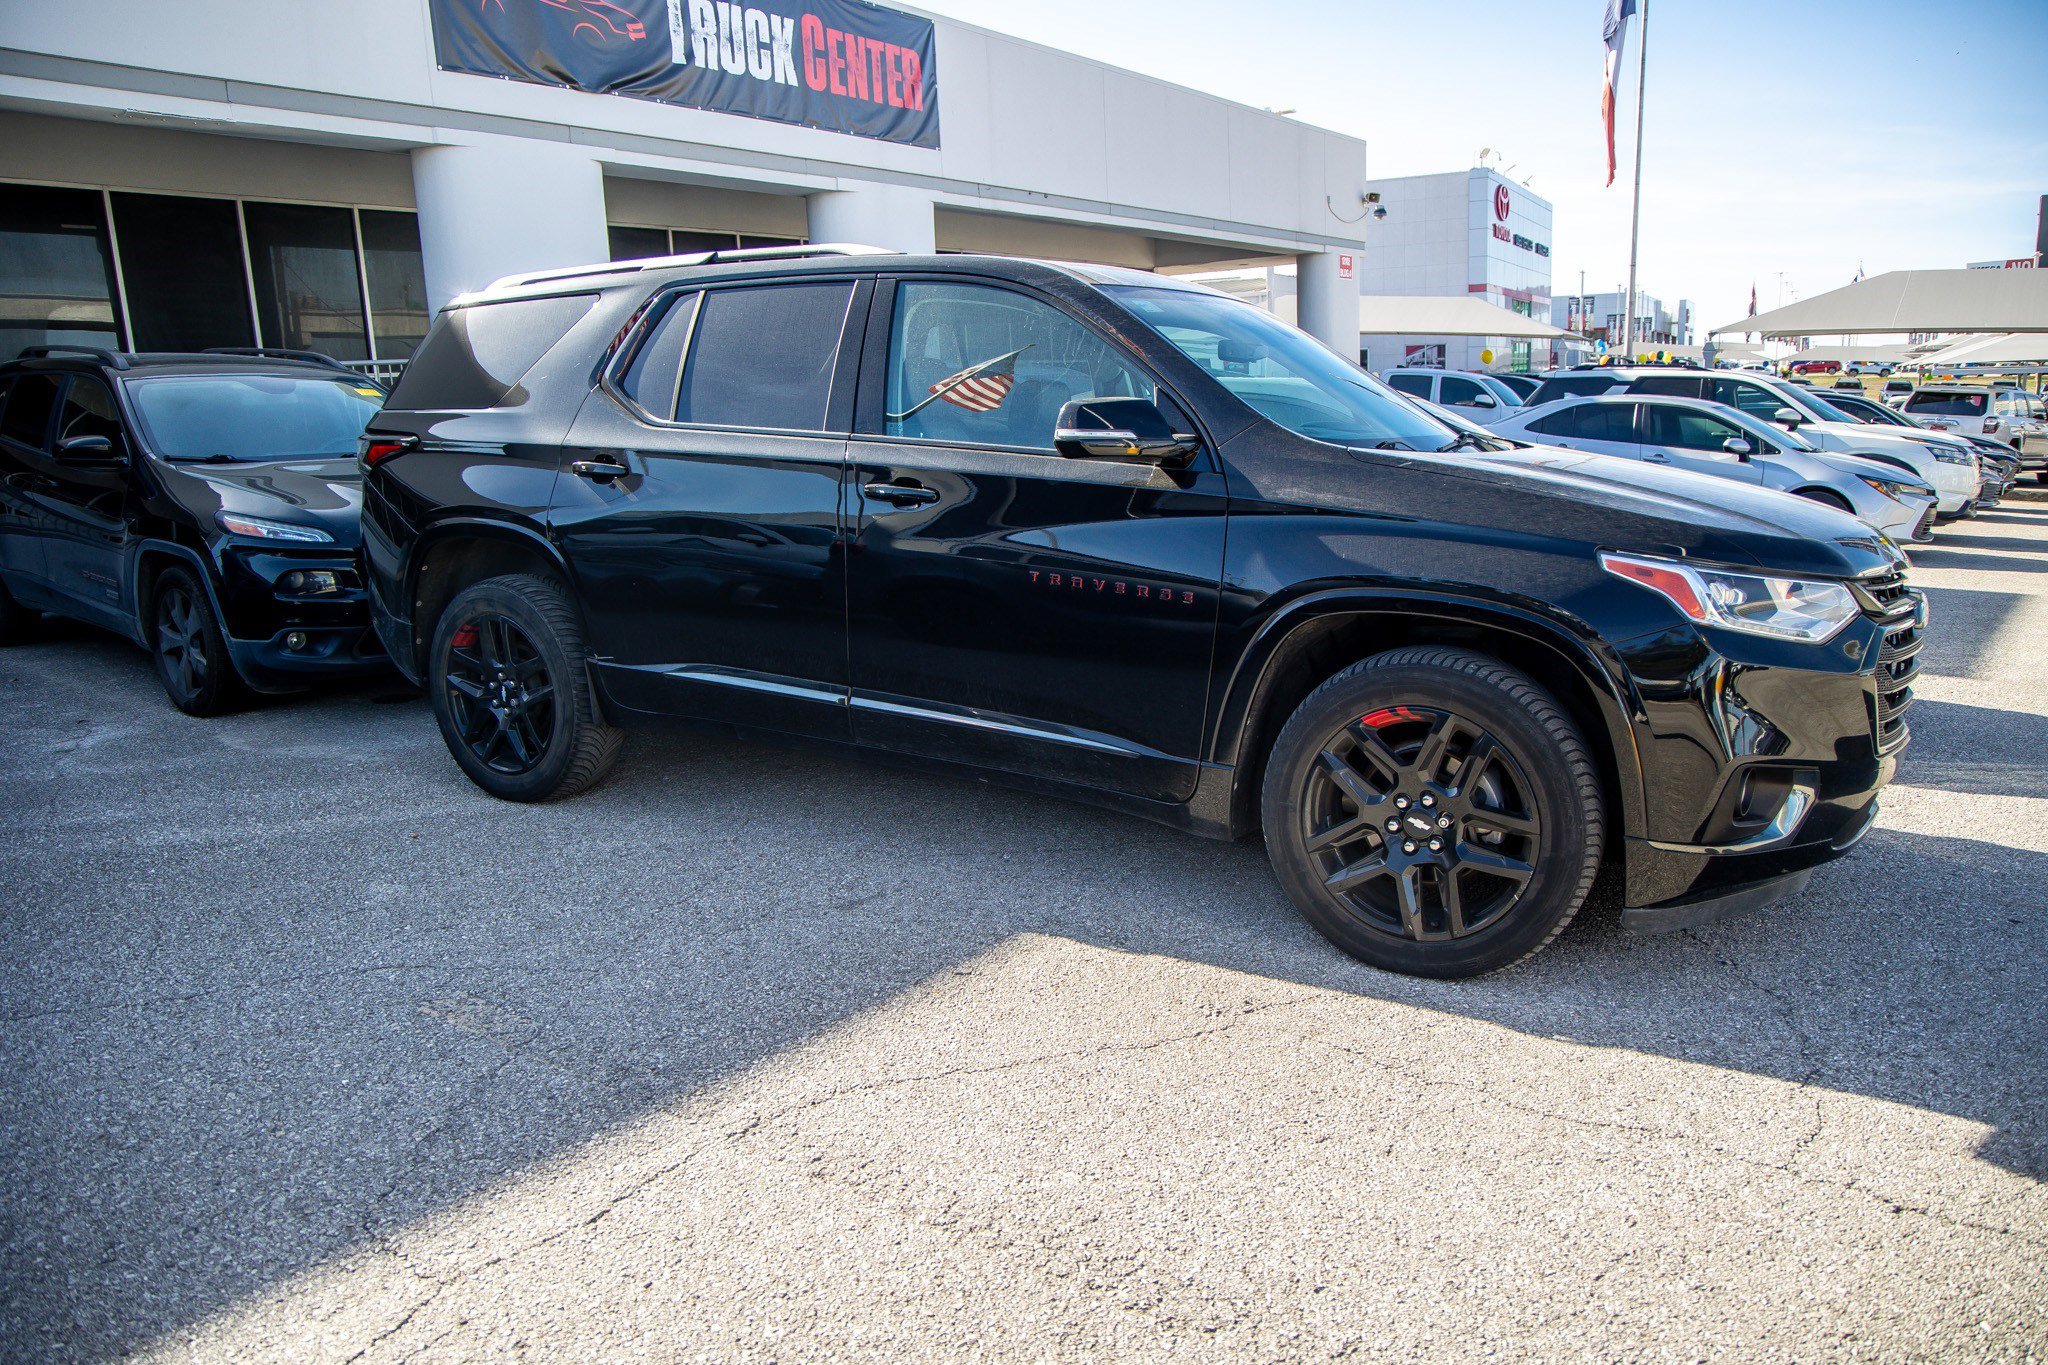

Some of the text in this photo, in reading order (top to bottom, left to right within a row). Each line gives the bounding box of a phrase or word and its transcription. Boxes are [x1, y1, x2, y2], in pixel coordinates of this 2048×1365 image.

[666, 0, 924, 111] TRUCK CENTER
[1029, 570, 1194, 604] TRAVERSE
